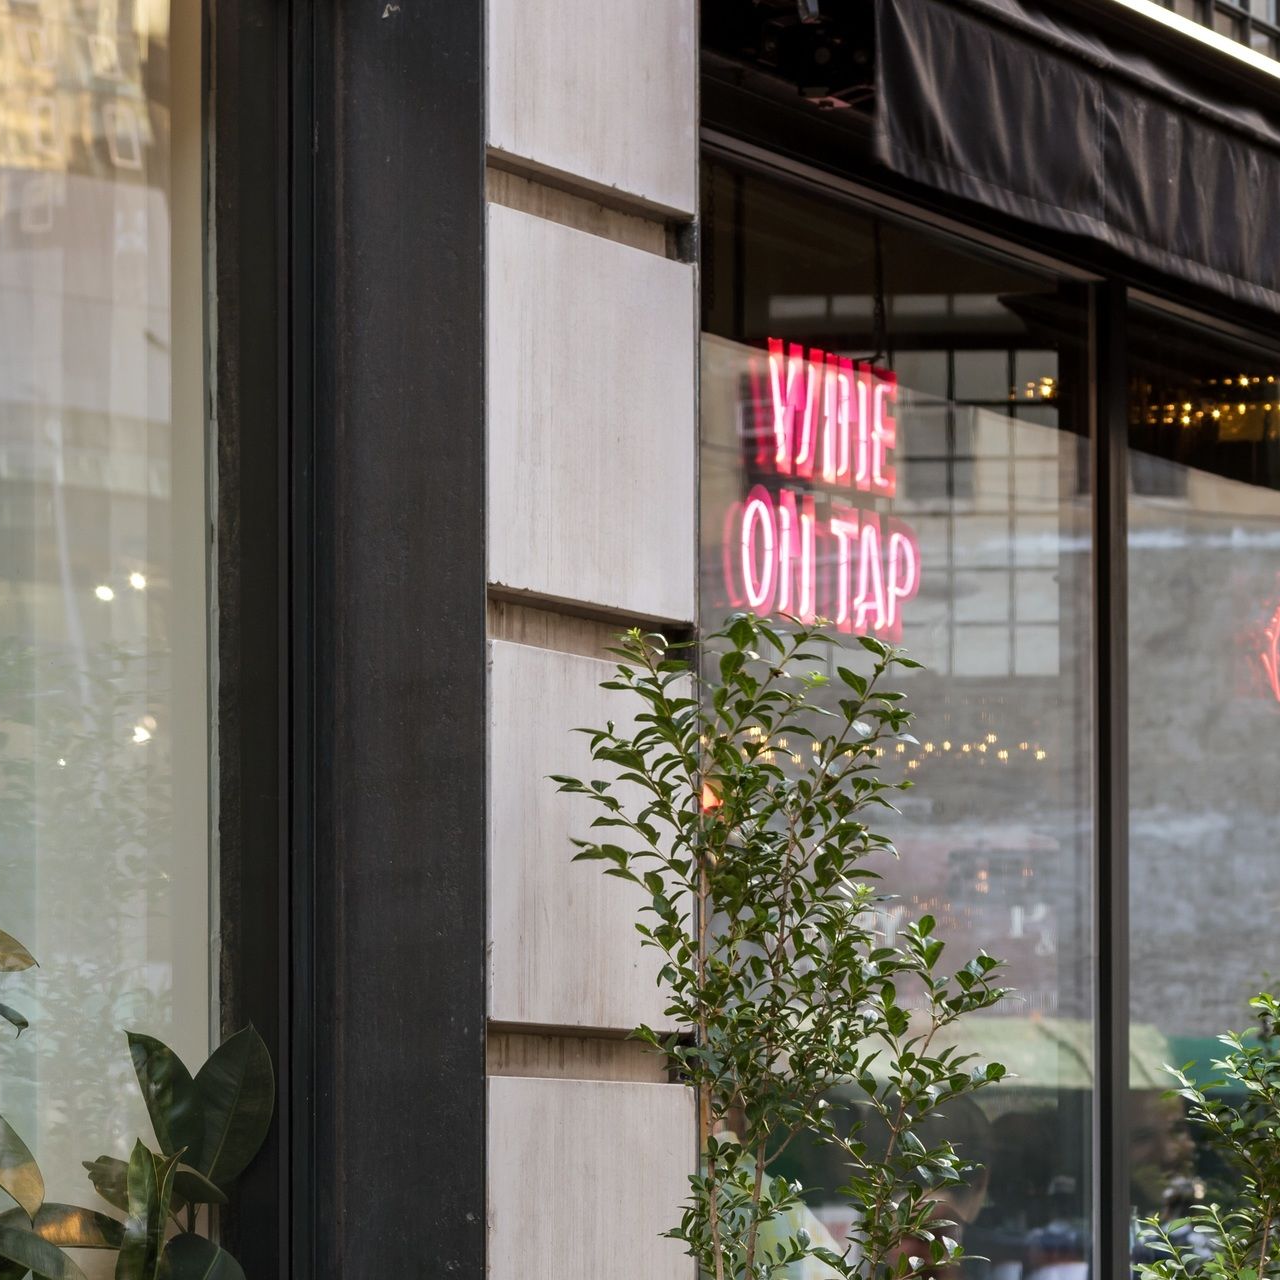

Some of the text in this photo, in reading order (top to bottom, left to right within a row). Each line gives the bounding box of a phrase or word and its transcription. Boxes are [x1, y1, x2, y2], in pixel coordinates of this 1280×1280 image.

[768, 338, 896, 497] WINE
[741, 486, 921, 642] ON TAP
